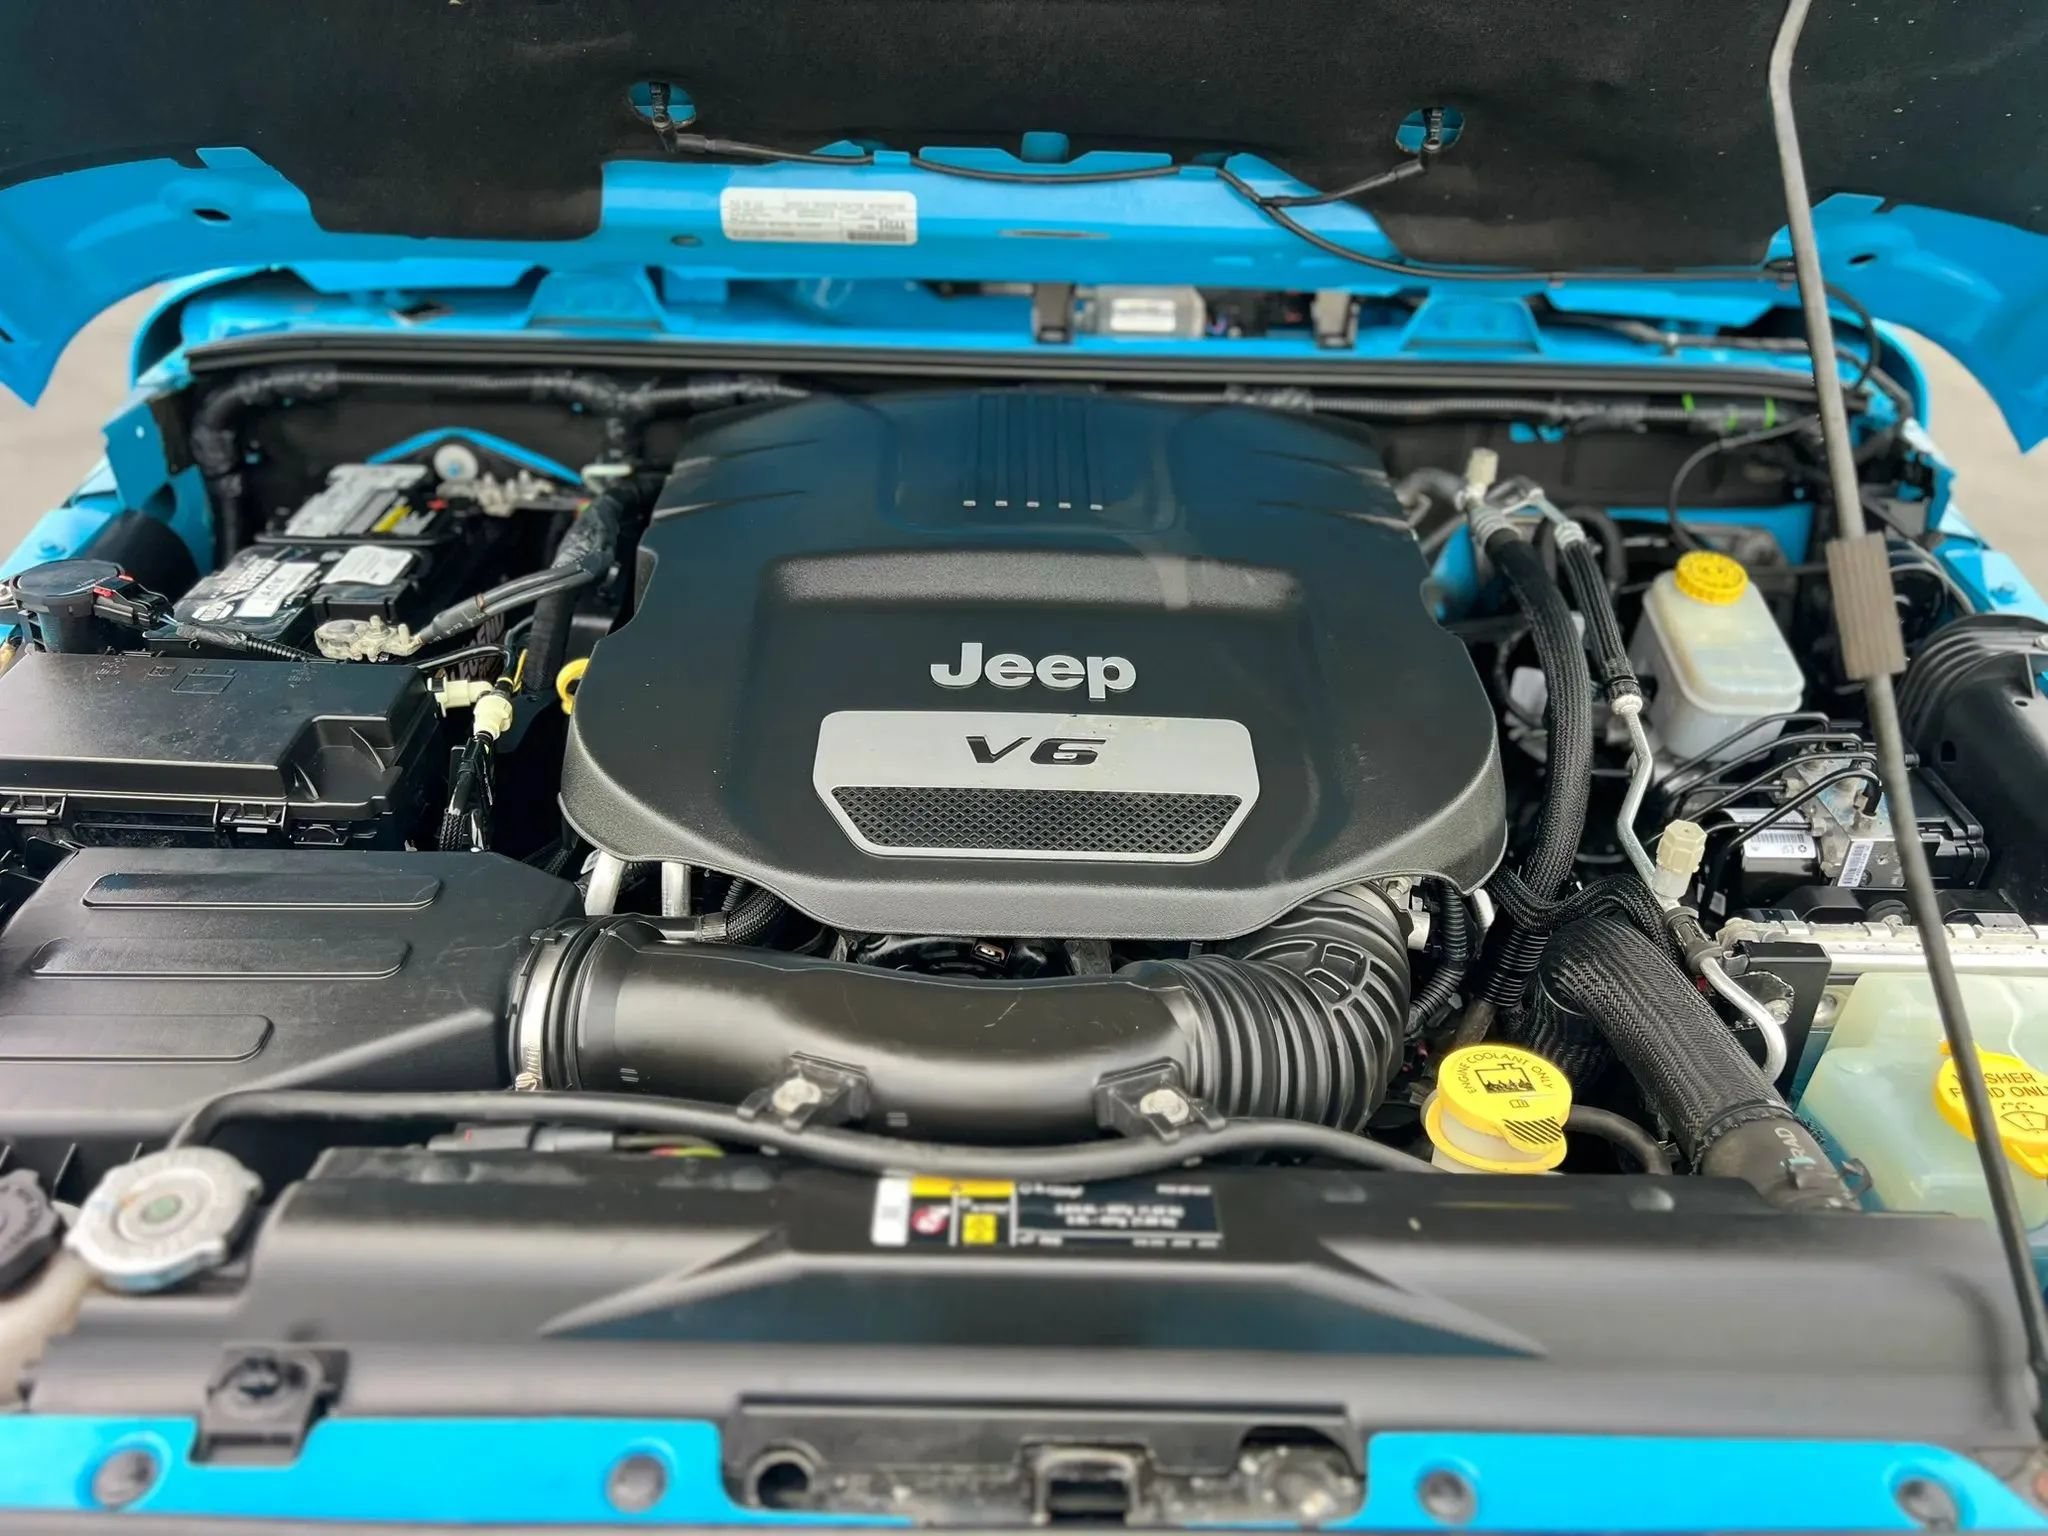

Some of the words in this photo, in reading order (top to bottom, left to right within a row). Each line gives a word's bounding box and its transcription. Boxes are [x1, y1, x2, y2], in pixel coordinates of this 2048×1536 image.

[930, 642, 1137, 701] Jeep
[965, 736, 1107, 765] V6
[1466, 1052, 1528, 1066] COOLANT
[1456, 1062, 1477, 1094] ENGINE
[1531, 1065, 1553, 1089] ONLY
[1952, 1071, 2037, 1084] SHER
[1949, 1087, 2005, 1098] FID
